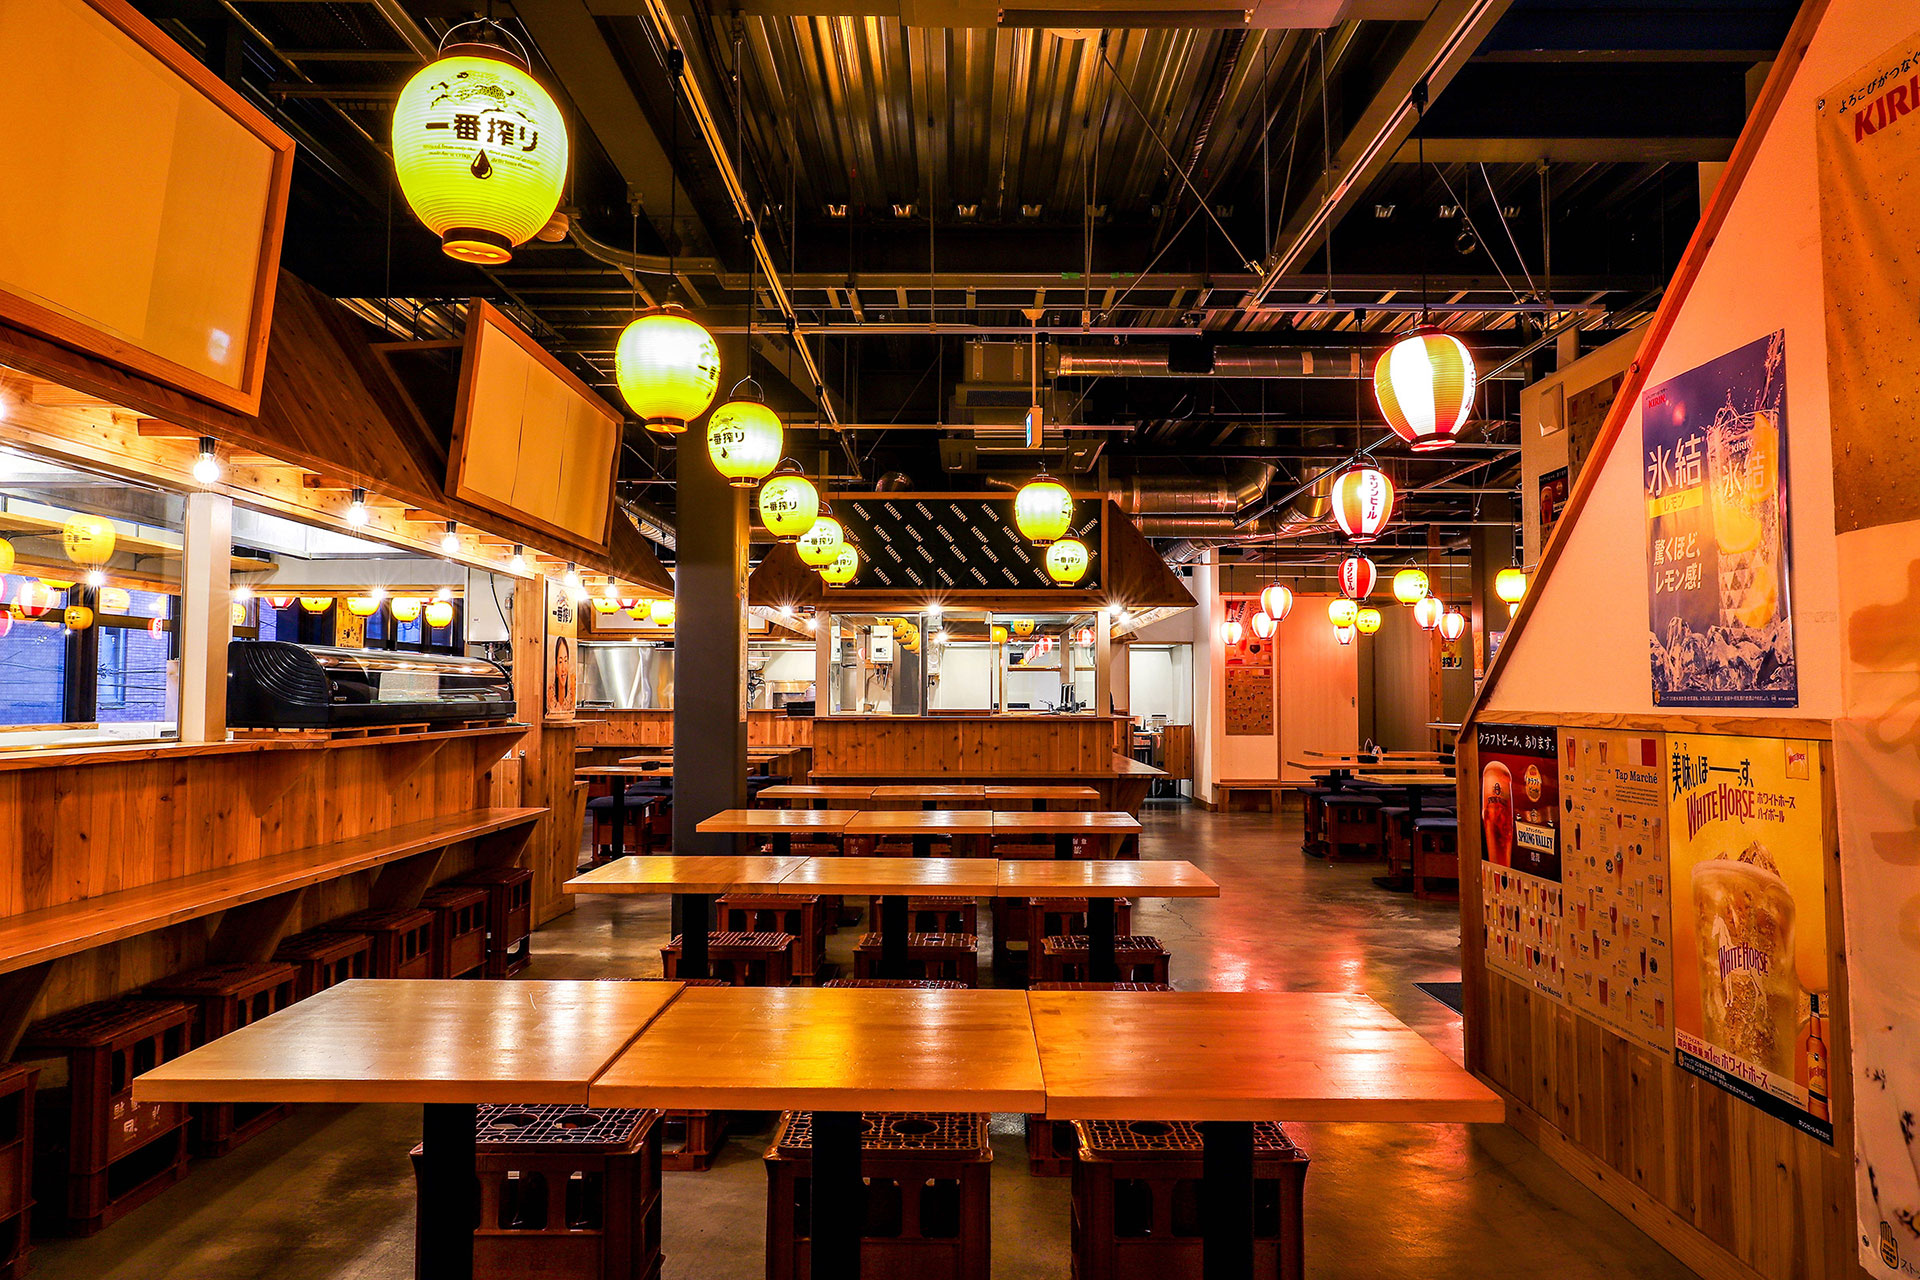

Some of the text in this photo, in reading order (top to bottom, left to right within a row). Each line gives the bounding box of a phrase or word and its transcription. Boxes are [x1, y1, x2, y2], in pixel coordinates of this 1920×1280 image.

[1854, 74, 1920, 143] KIRI
[425, 113, 538, 152] 一番搾り
[1648, 394, 1666, 408] KIRIN
[1732, 438, 1753, 453] KIRIN
[1648, 433, 1702, 496] 氷結
[1722, 451, 1767, 497] 氷結
[763, 500, 797, 512] 一番搾り
[1366, 474, 1379, 520] キリンビール
[1664, 495, 1686, 512] レモン
[853, 503, 871, 521] KIRIN
[884, 502, 902, 520] KIRIN
[916, 502, 933, 520] KIRIN
[950, 504, 968, 522] KIRIN
[981, 504, 999, 522] KIRIN
[843, 525, 860, 542] KIRIN
[874, 524, 892, 542] KIRIN
[906, 524, 923, 542] KIRIN
[937, 524, 954, 542] KIRIN
[971, 526, 989, 543] KIRIN
[1002, 526, 1020, 543] KIRIN
[1080, 518, 1098, 536] KIRIN
[855, 544, 871, 563] KIRIN
[885, 545, 902, 563] KIRIN
[916, 545, 934, 563] KIRIN
[950, 545, 967, 563] KIRIN
[981, 545, 999, 563] KIRIN
[1013, 545, 1030, 563] KIRIN
[1654, 532, 1701, 566] 驚くほど、
[874, 567, 891, 585] KIRIN
[906, 567, 923, 586] KIRIN
[937, 568, 954, 586] KIRIN
[970, 567, 988, 585] KIRIN
[1002, 567, 1019, 586] KIRIN
[1033, 568, 1051, 586] KIRIN
[1615, 769, 1658, 784] Tap Marché
[1757, 792, 1796, 809] ホワイトホース
[1757, 807, 1785, 823] ハイボール
